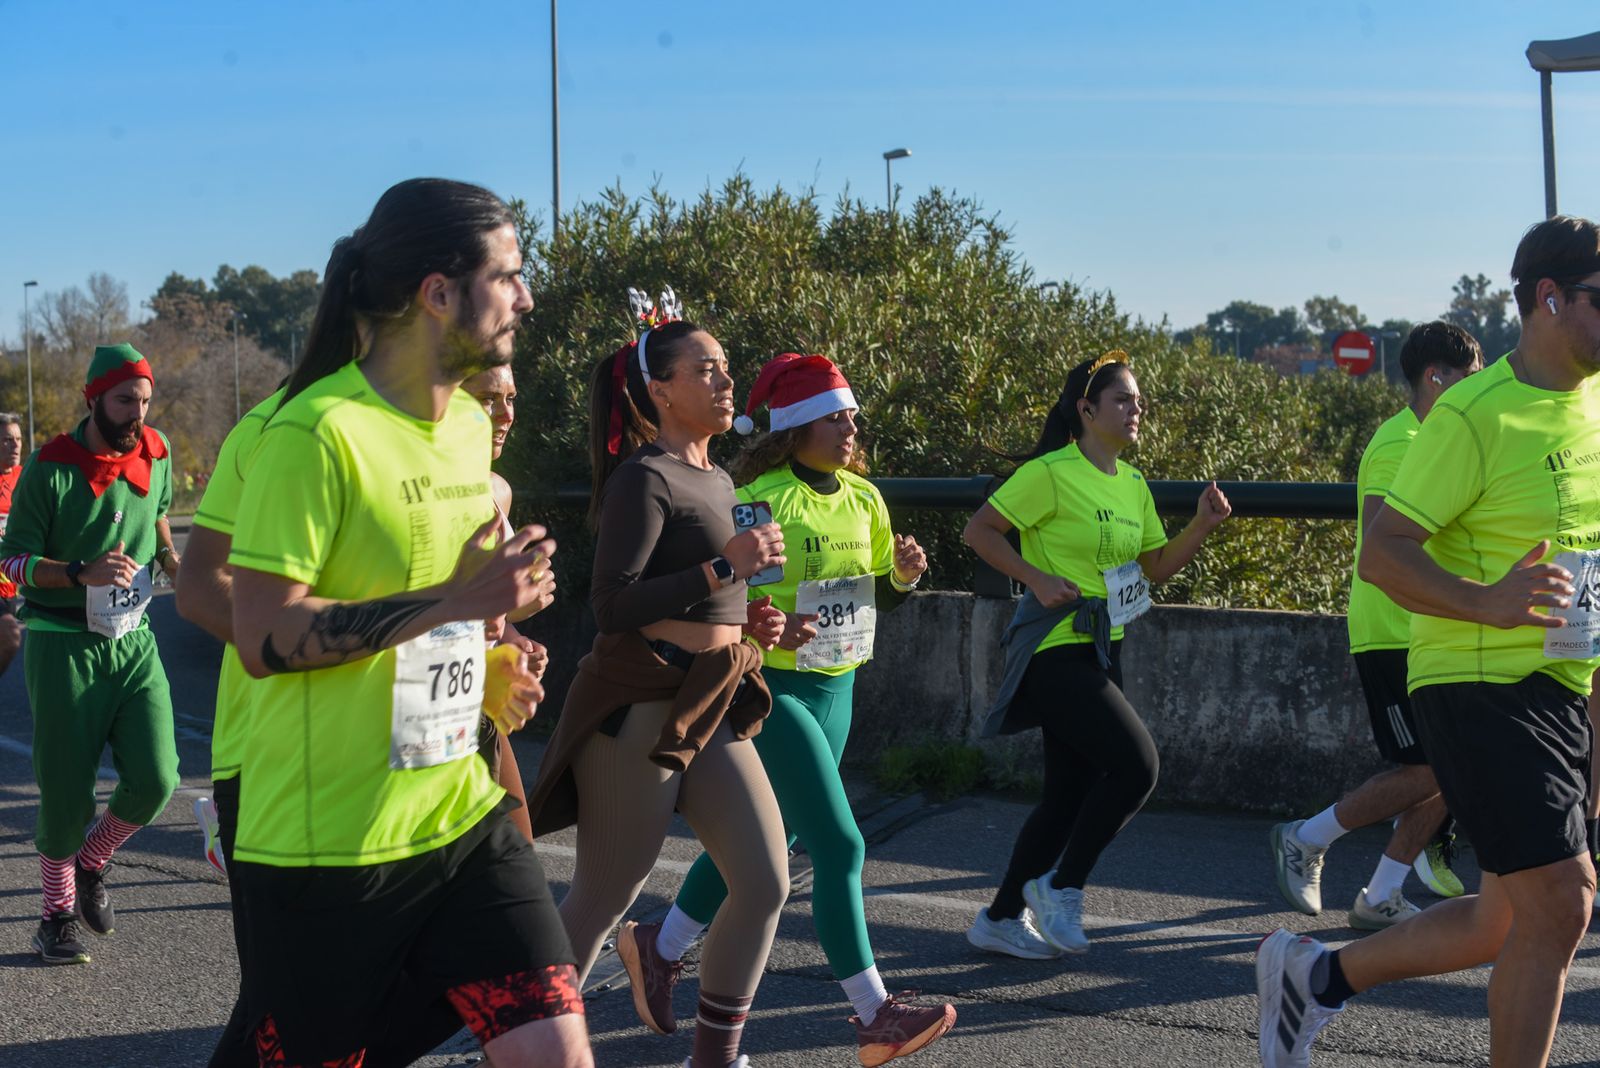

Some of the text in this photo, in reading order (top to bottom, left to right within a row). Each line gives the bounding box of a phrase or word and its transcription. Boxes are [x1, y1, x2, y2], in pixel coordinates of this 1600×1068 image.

[1545, 448, 1572, 472] 41º
[399, 475, 431, 504] 41º
[801, 535, 830, 553] 41º
[108, 588, 140, 607] 135
[817, 601, 855, 628] 381
[1559, 641, 1589, 649] IMDECO
[428, 657, 474, 702] 786
